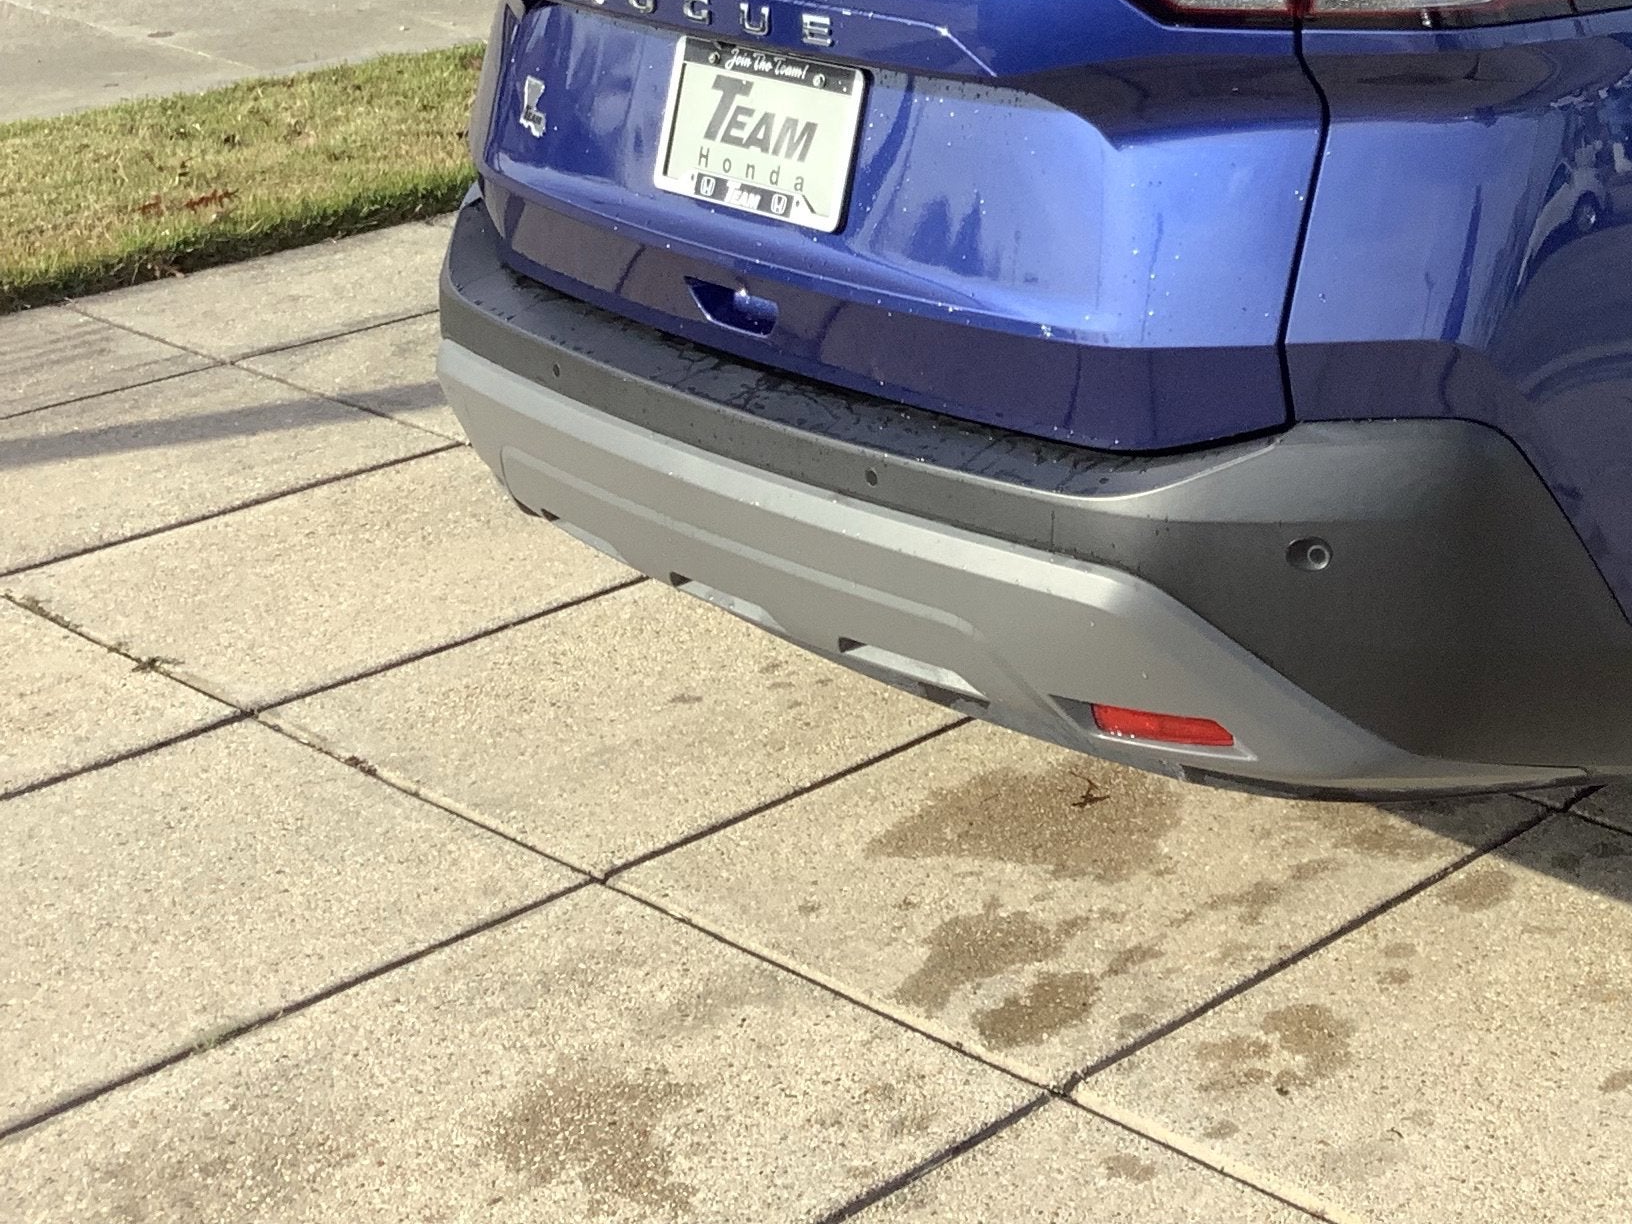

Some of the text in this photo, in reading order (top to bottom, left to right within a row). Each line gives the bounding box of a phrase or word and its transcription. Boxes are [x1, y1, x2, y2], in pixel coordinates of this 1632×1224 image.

[724, 48, 752, 70] Join
[703, 75, 818, 163] TEAM
[698, 146, 804, 192] Honda
[724, 180, 761, 210] TEAM
